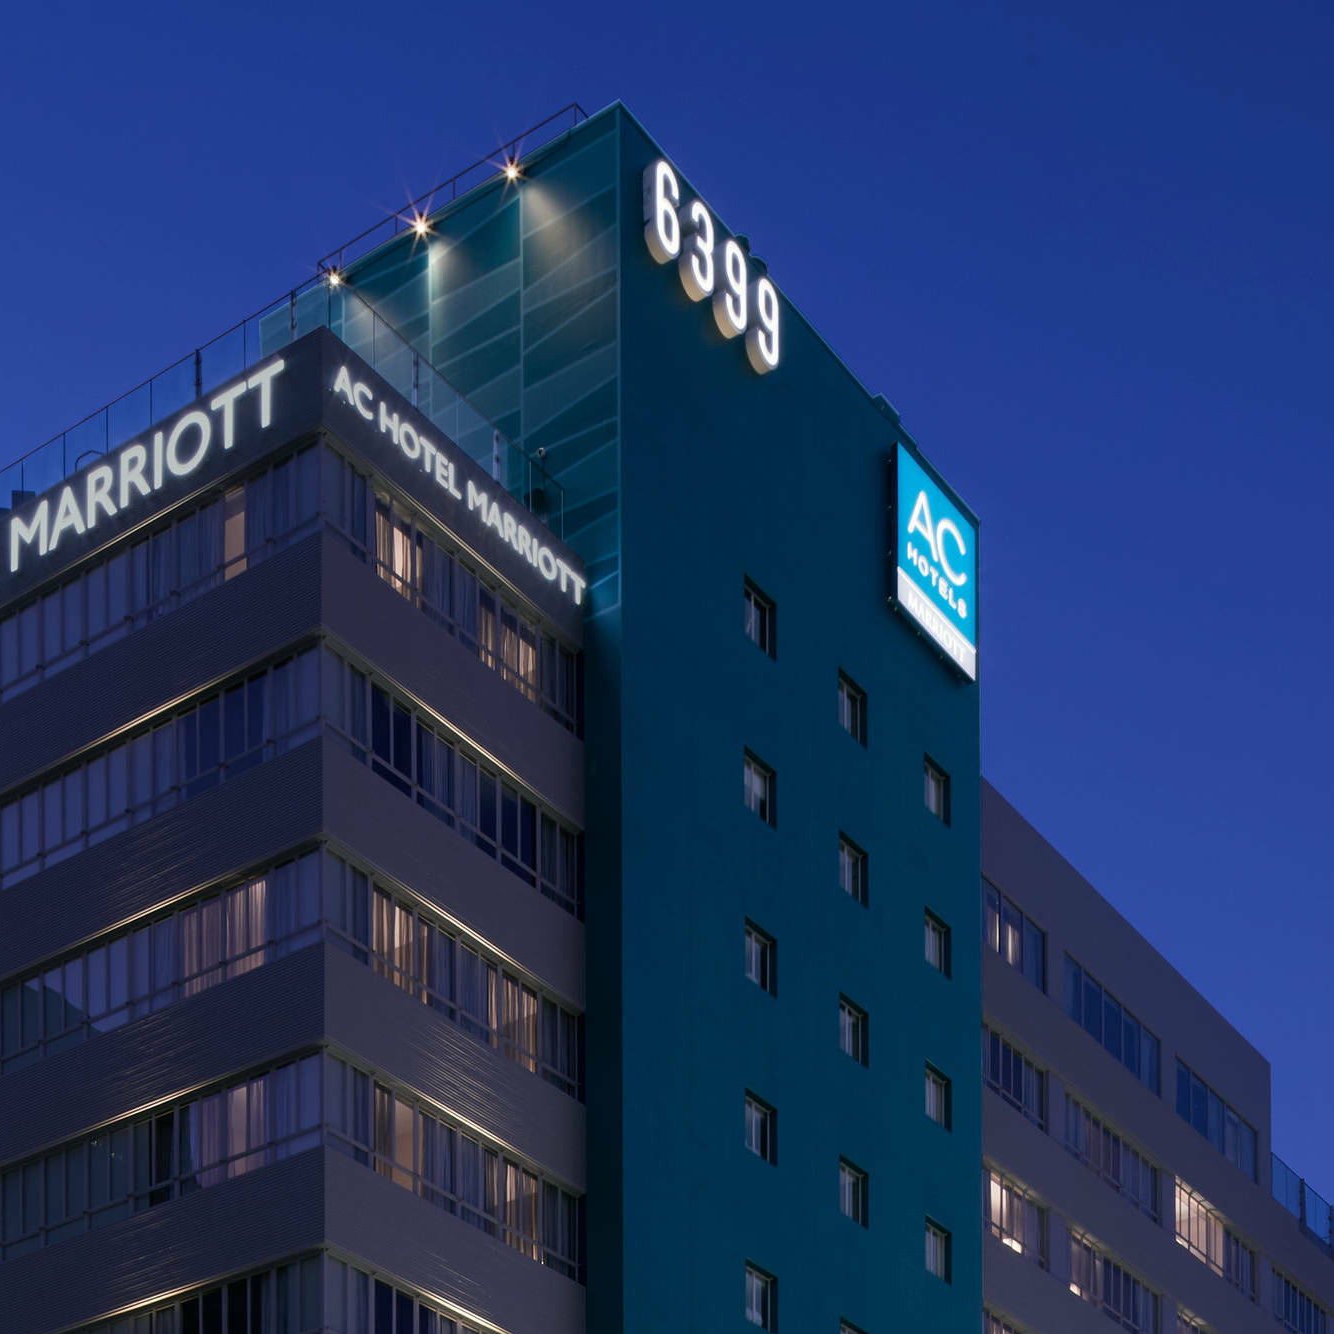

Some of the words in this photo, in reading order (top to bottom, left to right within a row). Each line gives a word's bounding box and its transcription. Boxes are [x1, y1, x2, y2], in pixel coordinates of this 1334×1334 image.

[650, 160, 780, 371] 6399
[10, 359, 286, 573] MARRIOTT
[333, 365, 374, 421] AC
[379, 401, 462, 500] HOTEL
[467, 480, 586, 605] MARRIOTT
[907, 491, 967, 586] AC
[907, 541, 968, 619] HOTELS
[907, 590, 966, 663] MARRIOTT
